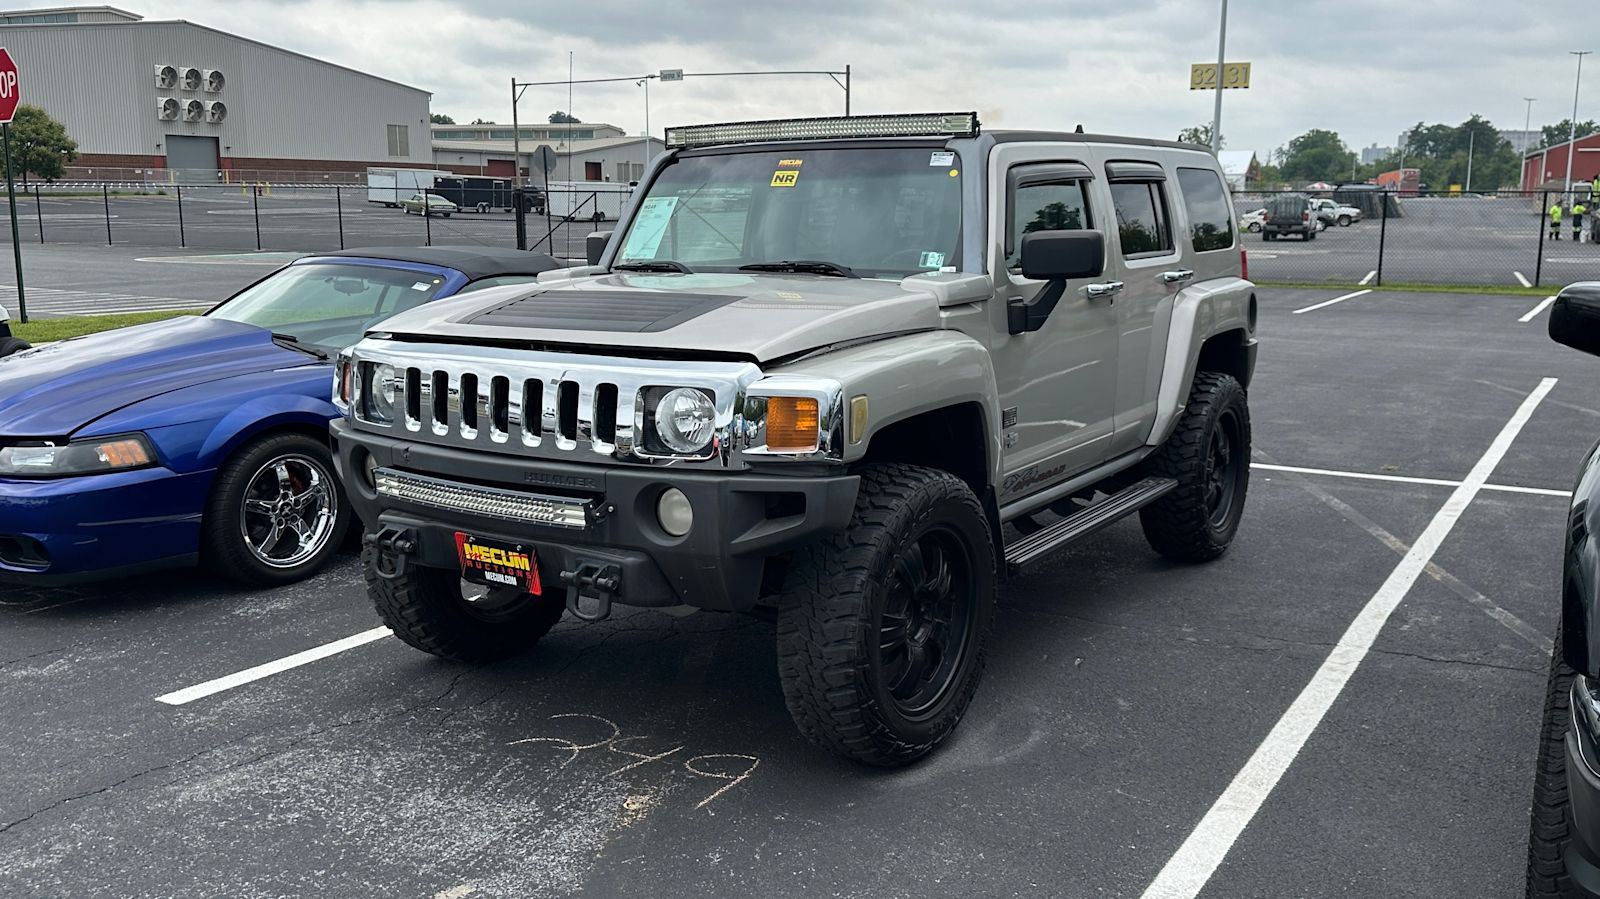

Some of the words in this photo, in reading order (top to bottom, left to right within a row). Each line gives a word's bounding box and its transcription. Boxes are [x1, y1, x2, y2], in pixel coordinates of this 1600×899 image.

[0, 71, 16, 98] OP
[1193, 68, 1216, 85] 32
[1229, 67, 1248, 84] 31
[773, 174, 795, 183] NR
[524, 472, 597, 488] HUMMER
[463, 543, 530, 571] MECUM
[467, 560, 531, 579] AUCTIONS
[485, 571, 517, 586] MECUM.COM
